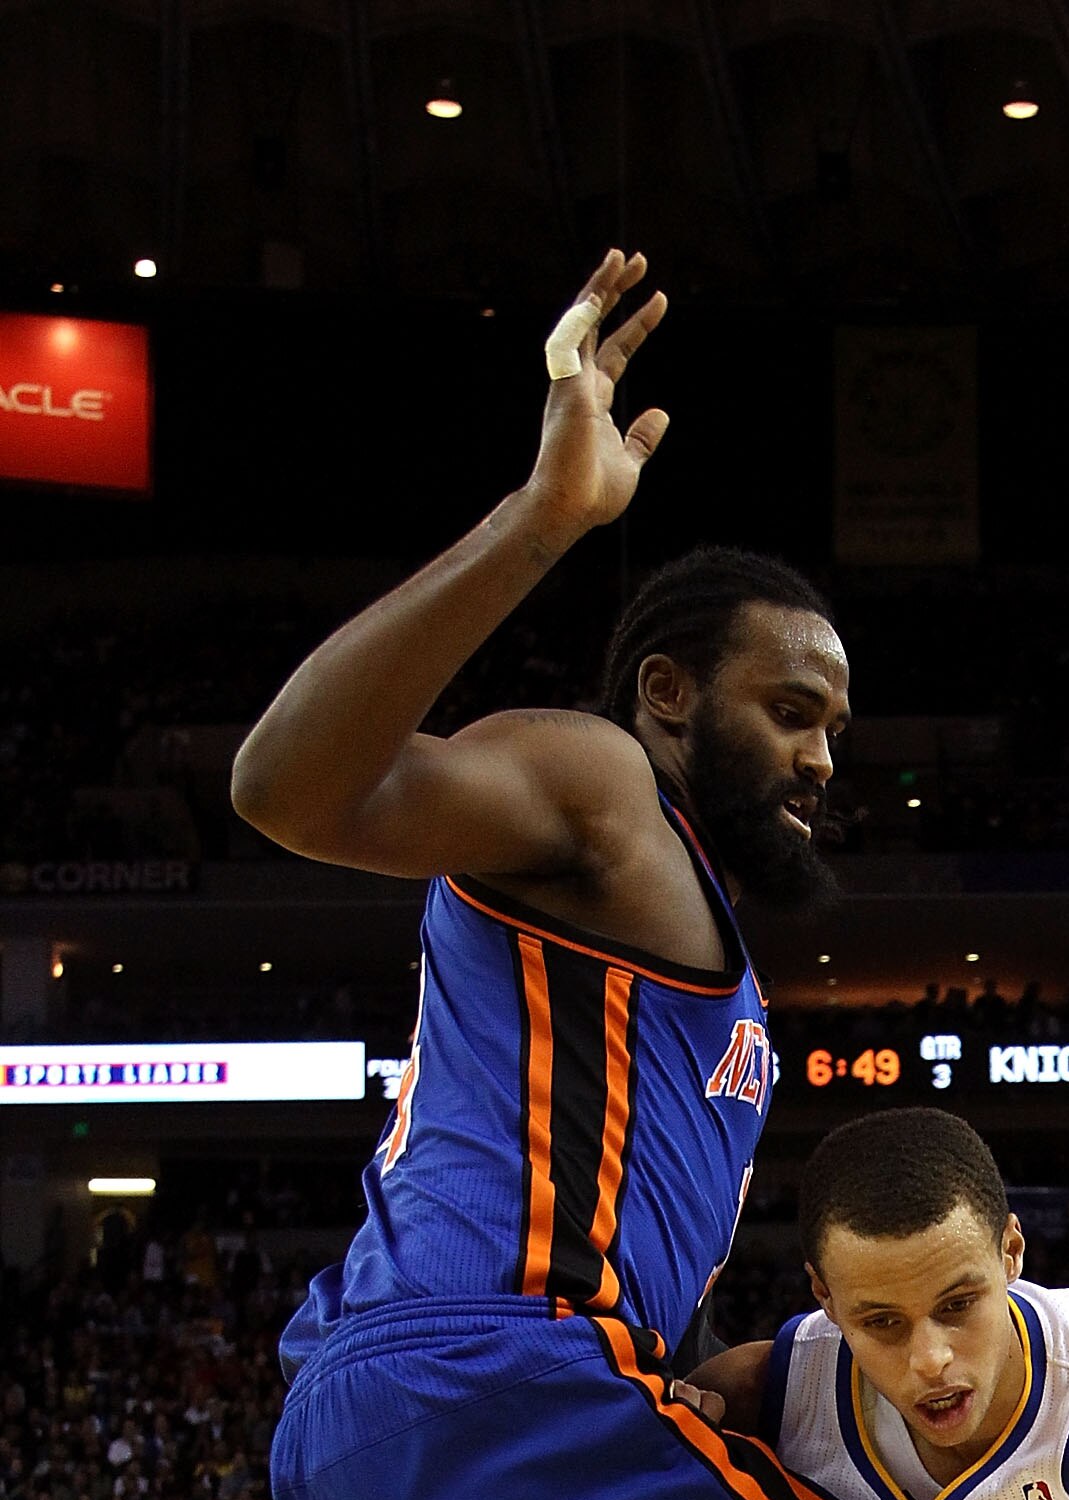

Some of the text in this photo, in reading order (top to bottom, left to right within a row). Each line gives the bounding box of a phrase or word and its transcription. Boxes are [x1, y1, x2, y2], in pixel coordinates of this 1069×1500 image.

[31, 860, 191, 892] CORNER
[13, 1061, 220, 1086] SPORTS LEADER
[805, 1048, 901, 1087] 6:49
[932, 1064, 952, 1088] 3
